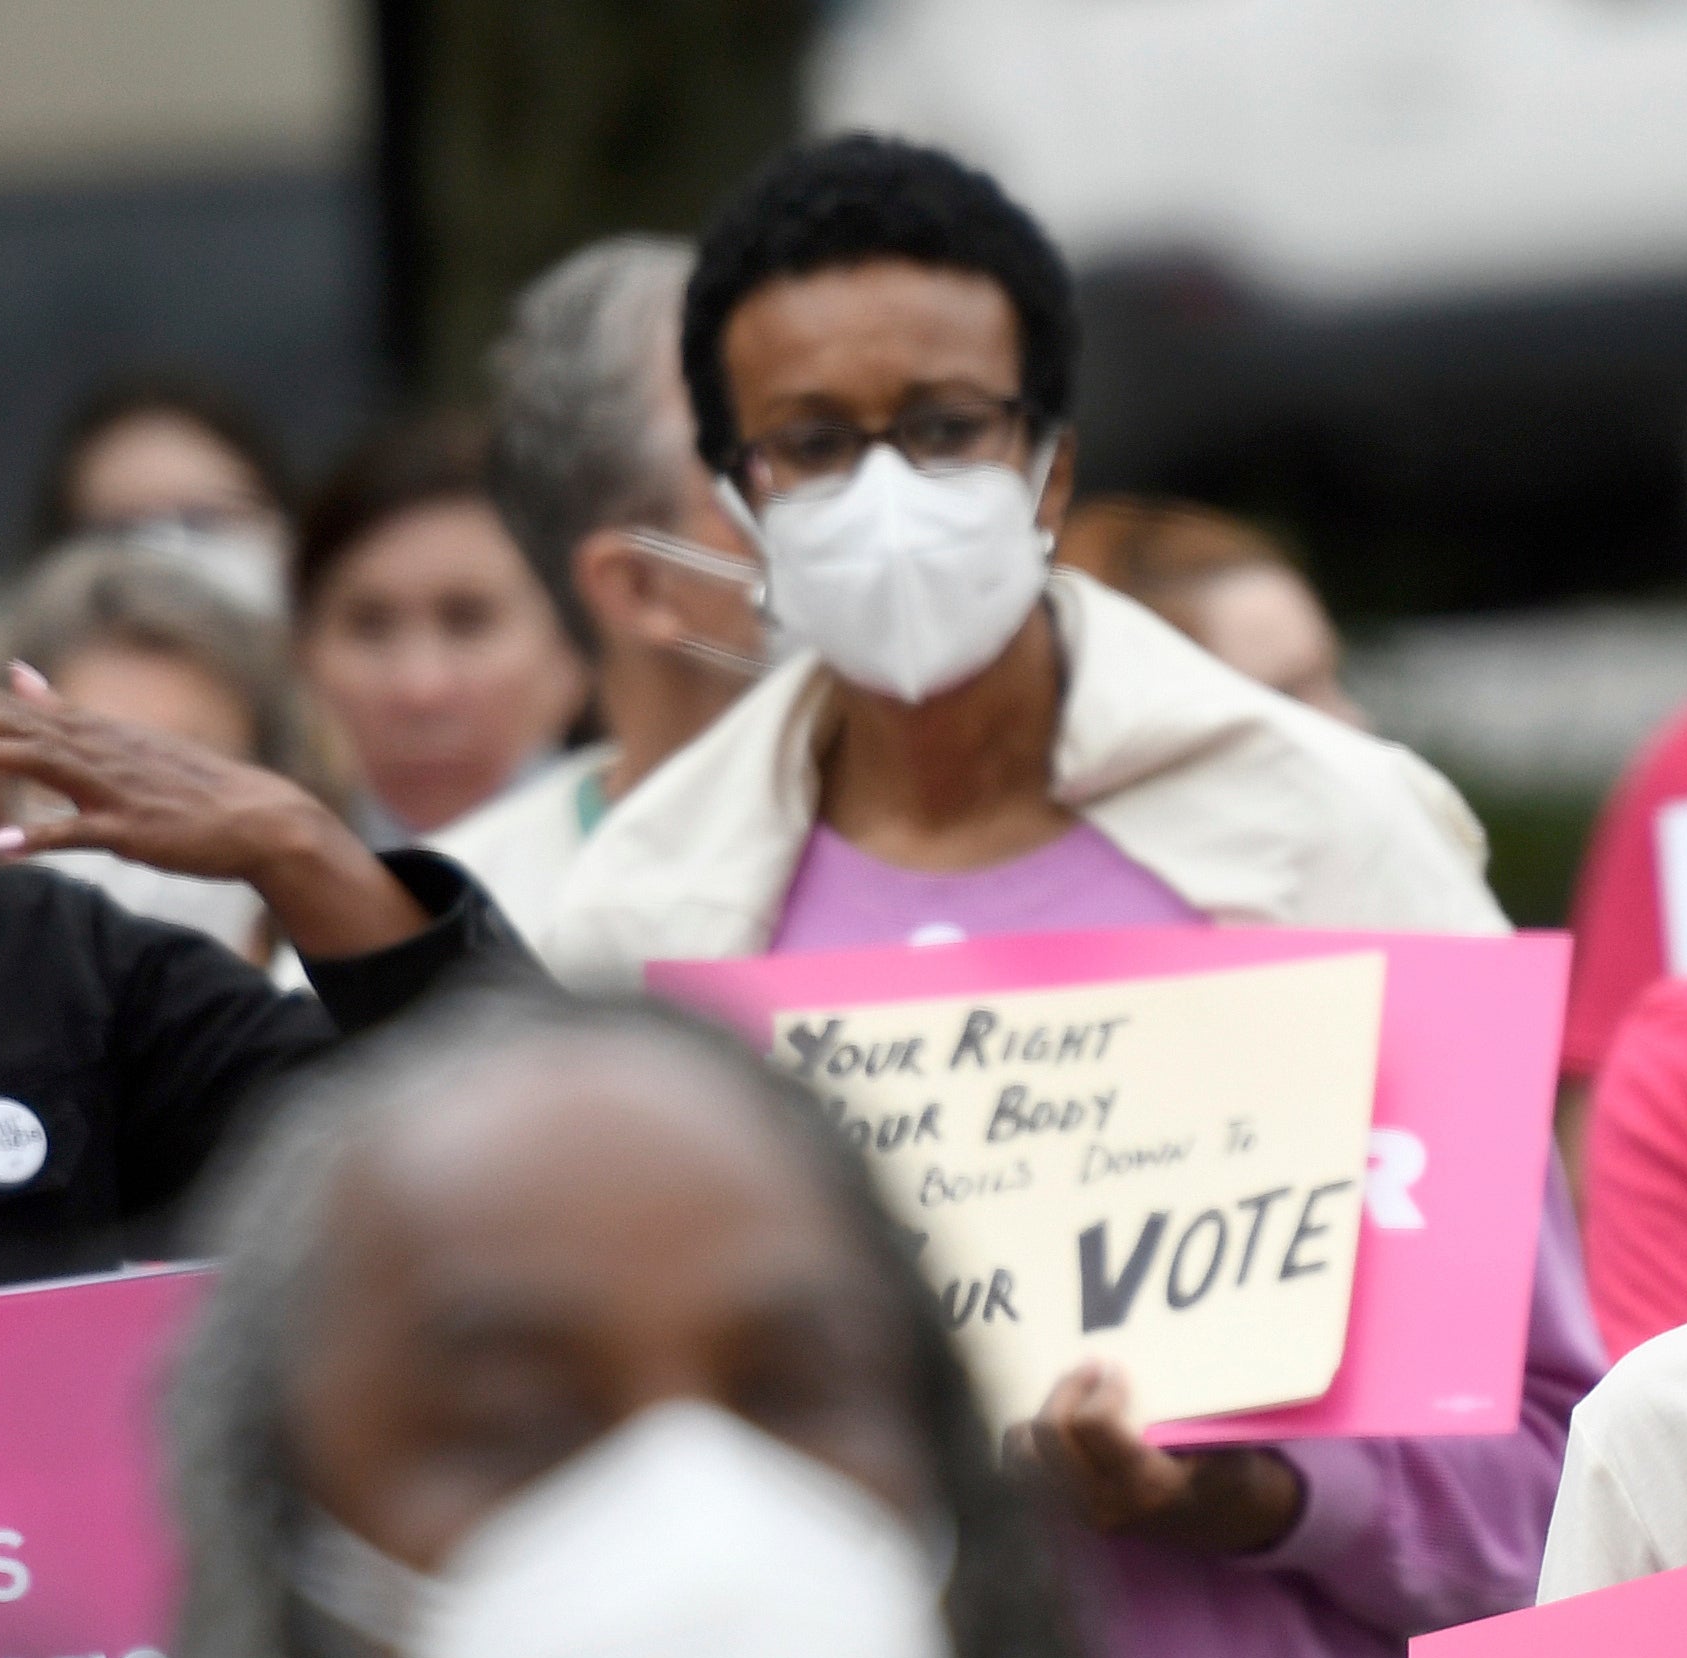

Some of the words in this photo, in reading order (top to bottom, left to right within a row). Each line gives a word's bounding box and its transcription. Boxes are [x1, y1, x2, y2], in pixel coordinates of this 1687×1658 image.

[786, 1018, 923, 1077] YOUR
[949, 1009, 1129, 1071] RIGHT
[826, 1100, 940, 1150] OUR
[985, 1082, 1117, 1144] BODY
[1078, 1136, 1196, 1186] DOWN
[1364, 1126, 1428, 1230] R
[1077, 1178, 1353, 1335] VOTE
